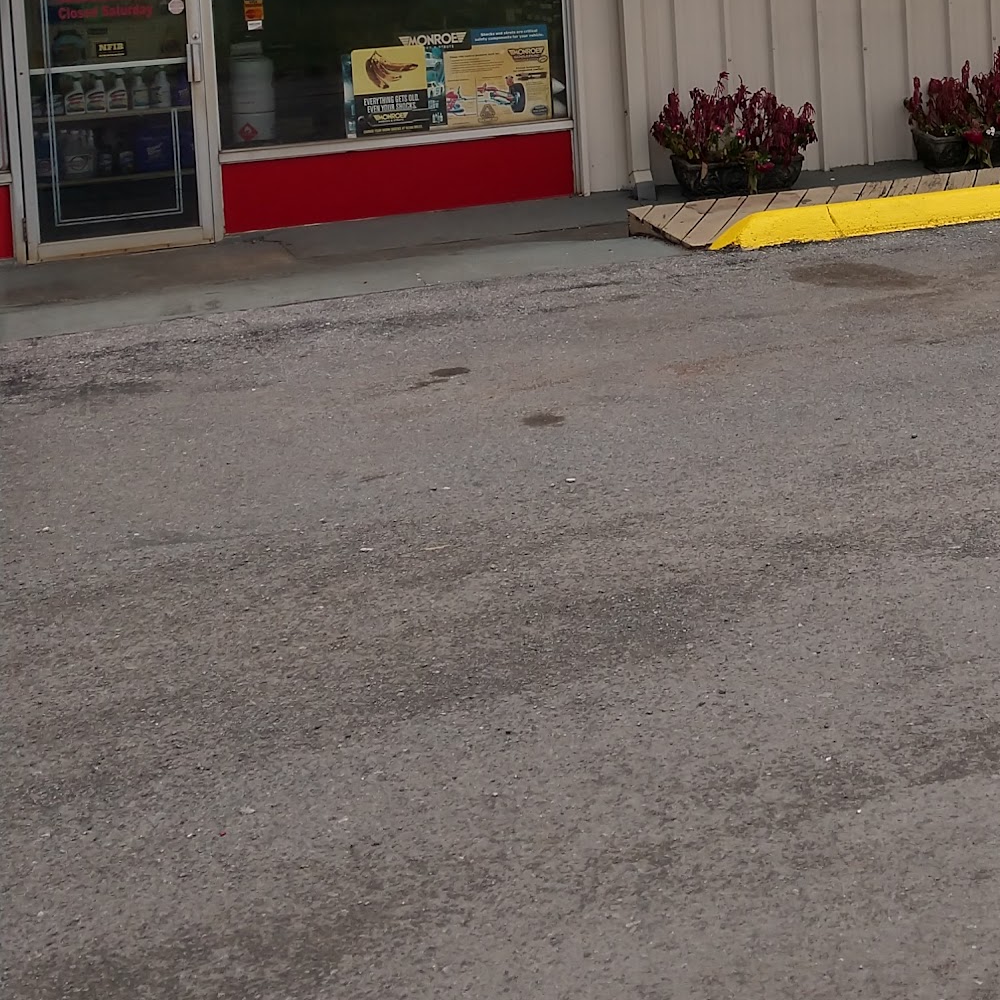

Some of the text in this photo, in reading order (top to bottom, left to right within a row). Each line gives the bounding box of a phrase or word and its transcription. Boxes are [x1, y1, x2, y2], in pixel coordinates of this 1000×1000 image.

[58, 3, 153, 20] Closed Saturday
[408, 32, 459, 46] MONROE
[98, 42, 124, 51] NFIB
[395, 94, 407, 103] GETS
[367, 105, 380, 113] EVEN
